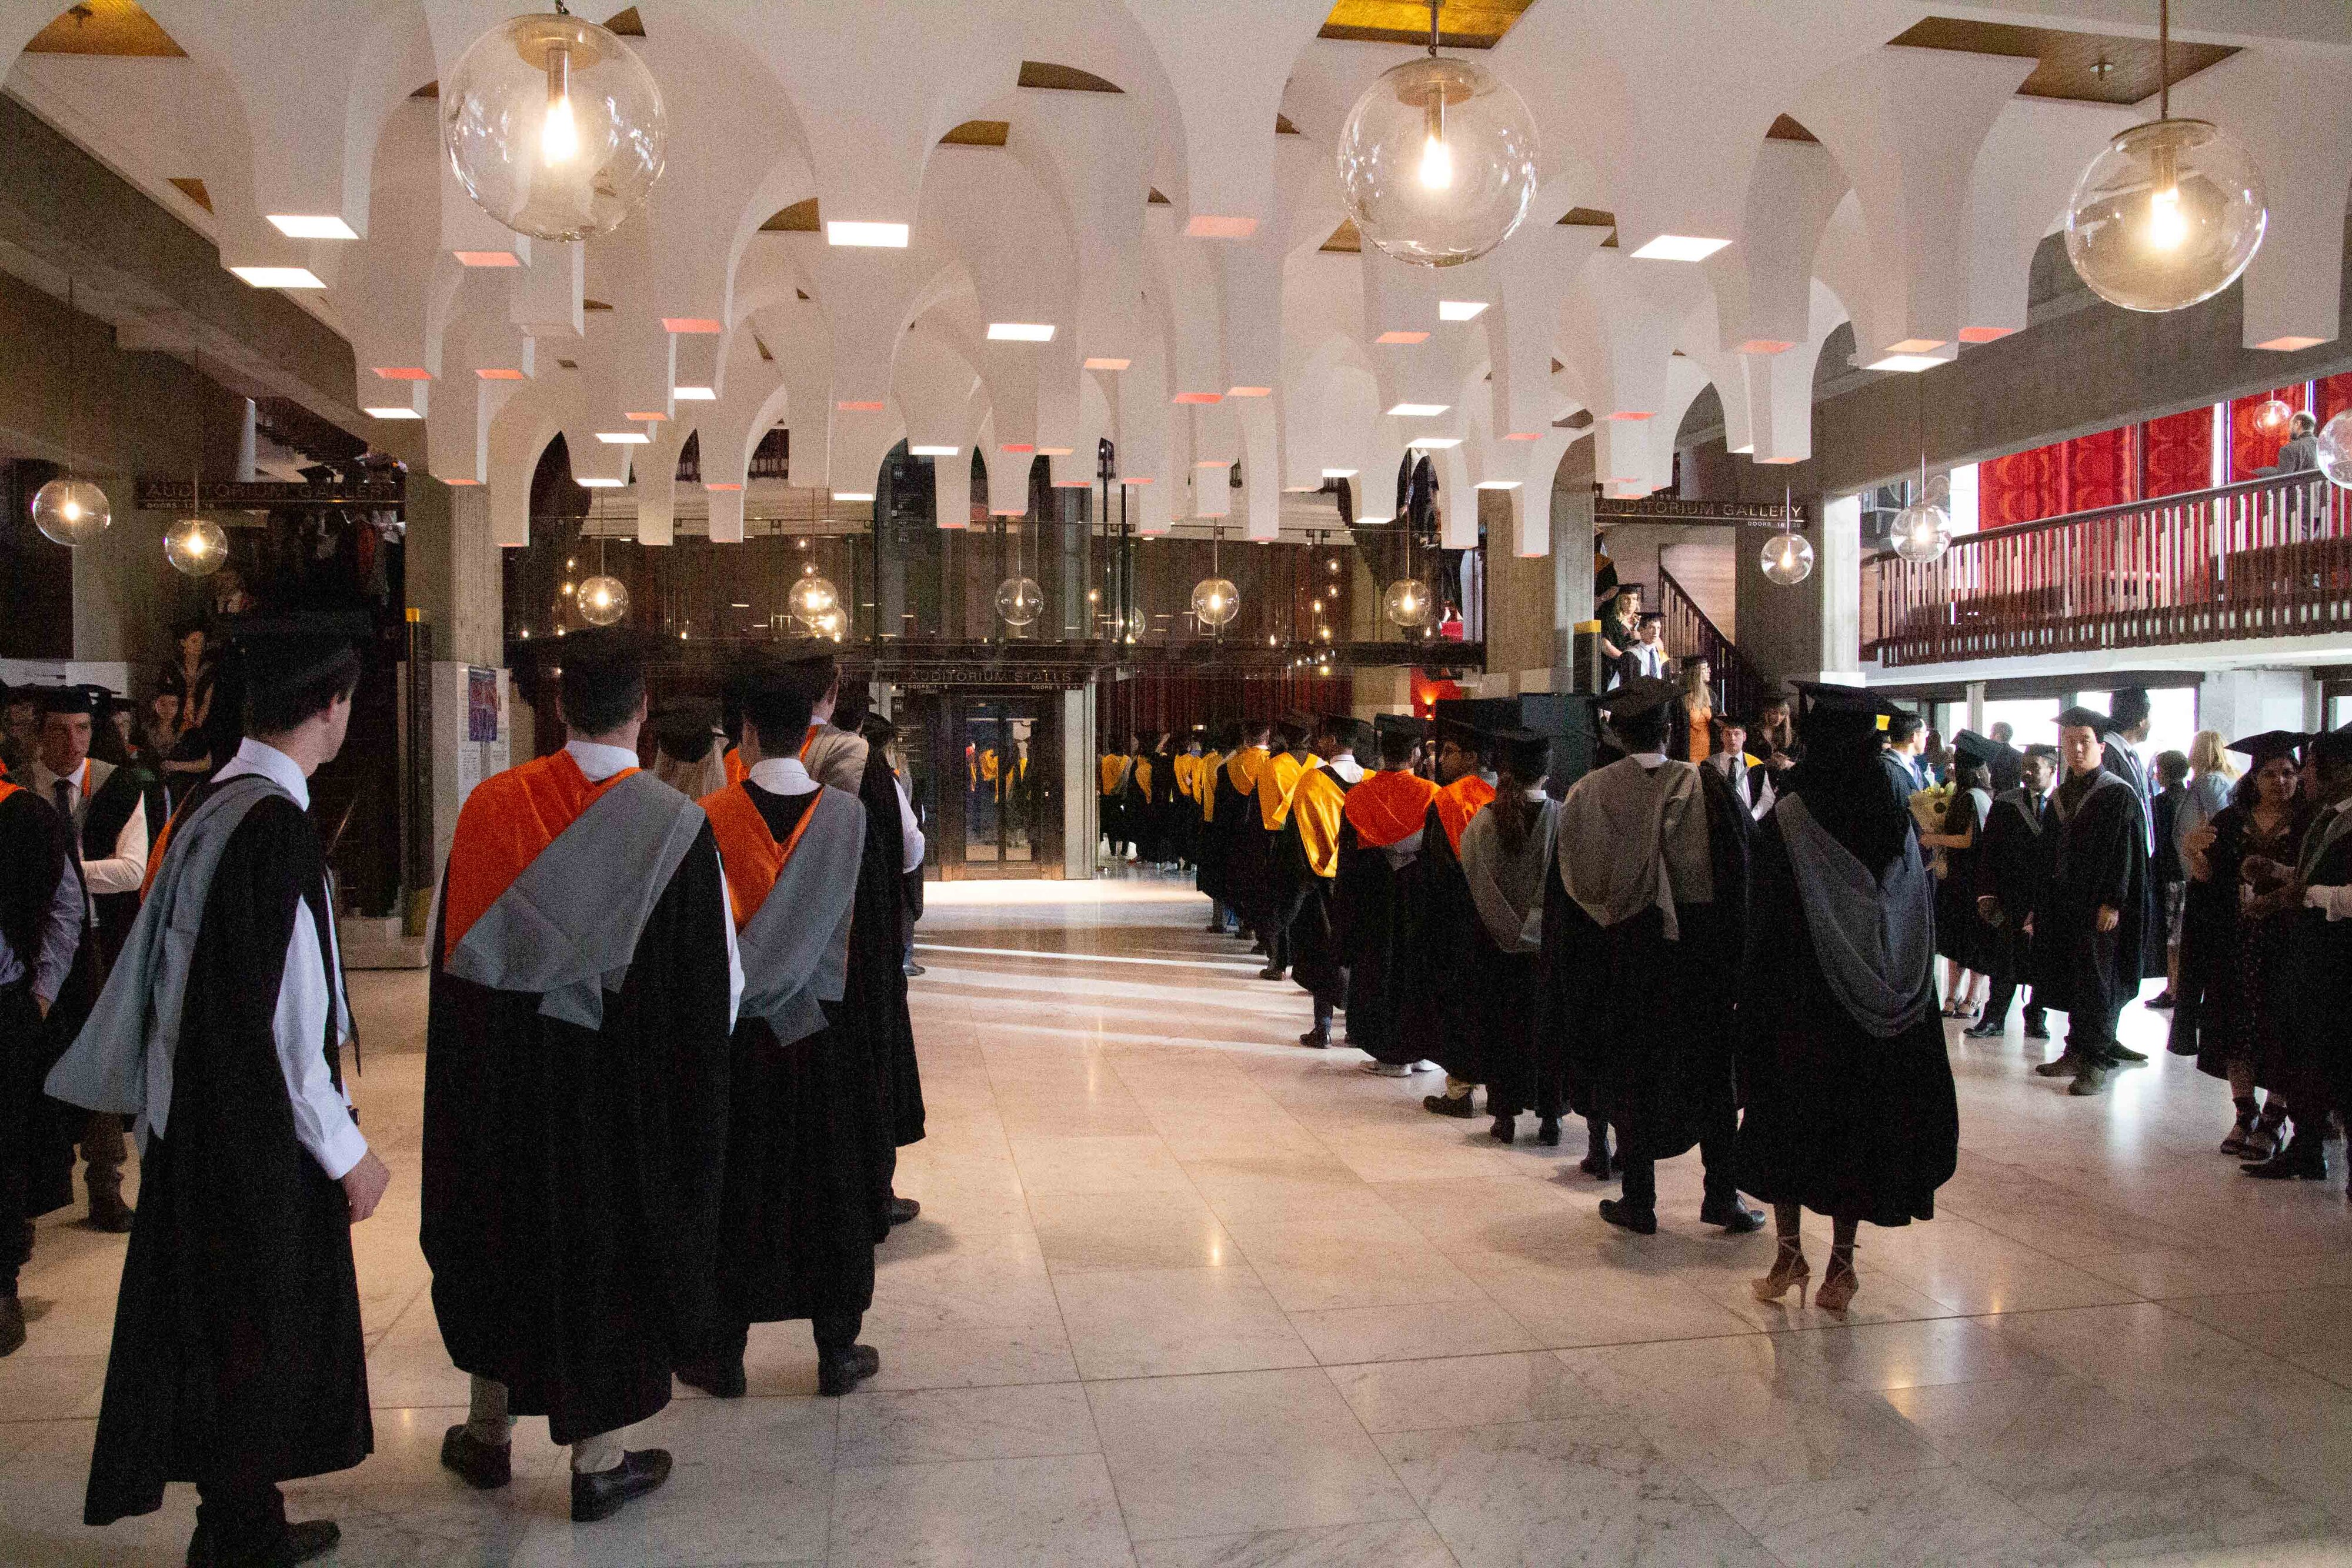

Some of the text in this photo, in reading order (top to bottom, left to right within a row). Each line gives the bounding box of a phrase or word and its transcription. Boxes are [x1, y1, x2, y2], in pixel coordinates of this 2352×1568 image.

[146, 483, 287, 498] AUDTORIUM
[1599, 500, 1714, 515] AUDITORIUM
[909, 672, 1070, 682] AUDITORIUM STALLS
